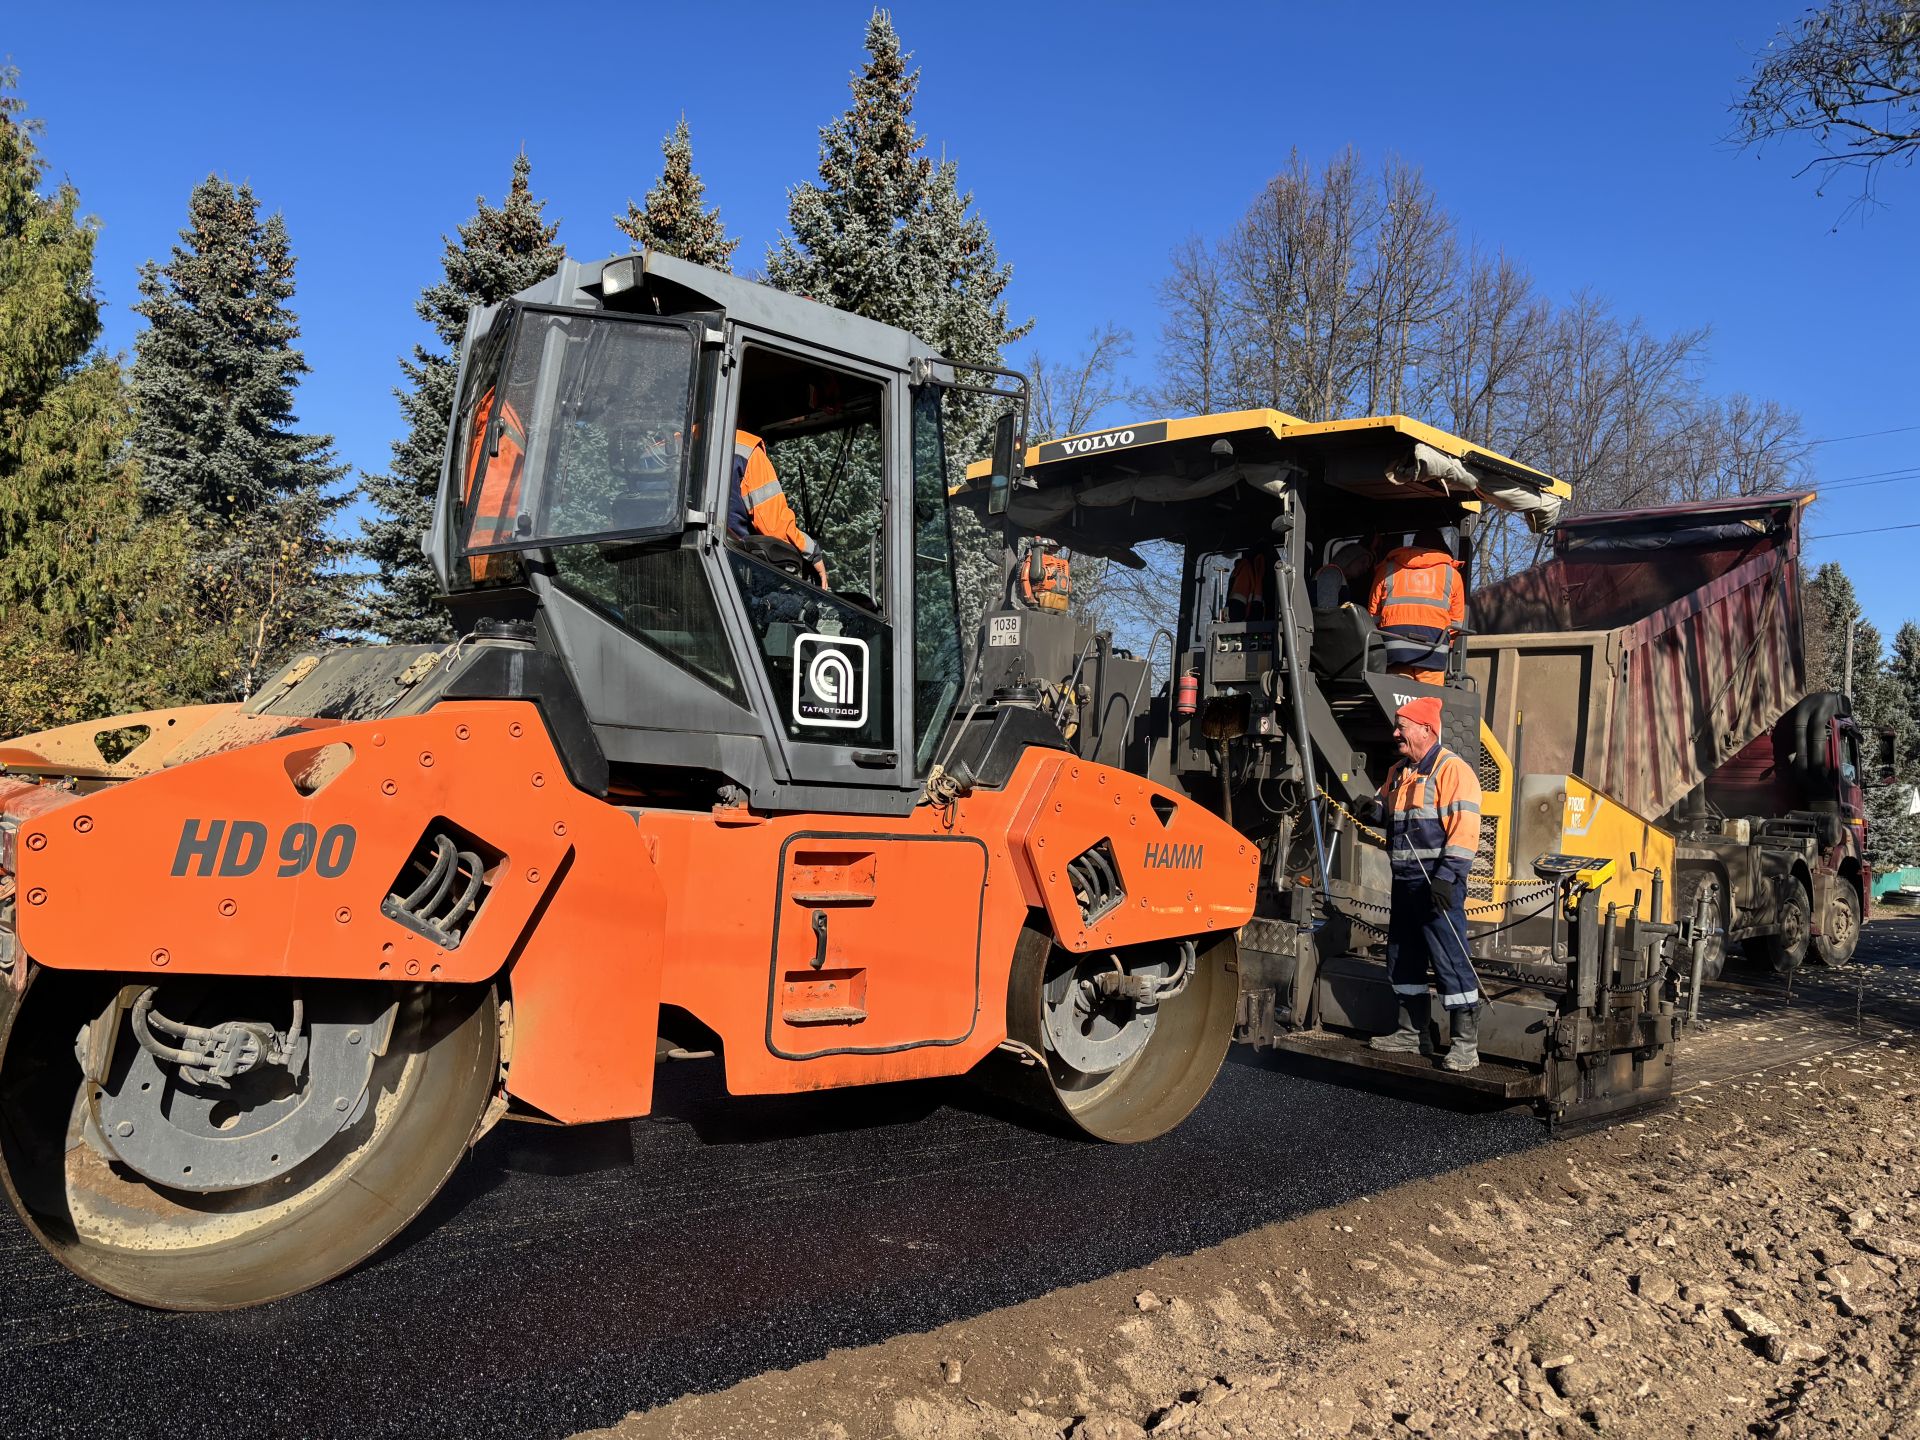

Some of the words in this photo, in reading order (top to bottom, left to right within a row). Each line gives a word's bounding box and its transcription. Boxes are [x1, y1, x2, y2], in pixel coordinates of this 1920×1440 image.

[1061, 430, 1135, 455] VOLVO
[994, 618, 1017, 631] 1038
[1008, 634, 1017, 644] 16
[802, 705, 860, 716] ТАТАВТОДОР
[170, 818, 268, 877] HD
[276, 822, 357, 879] 90
[1143, 842, 1204, 869] HAMM
